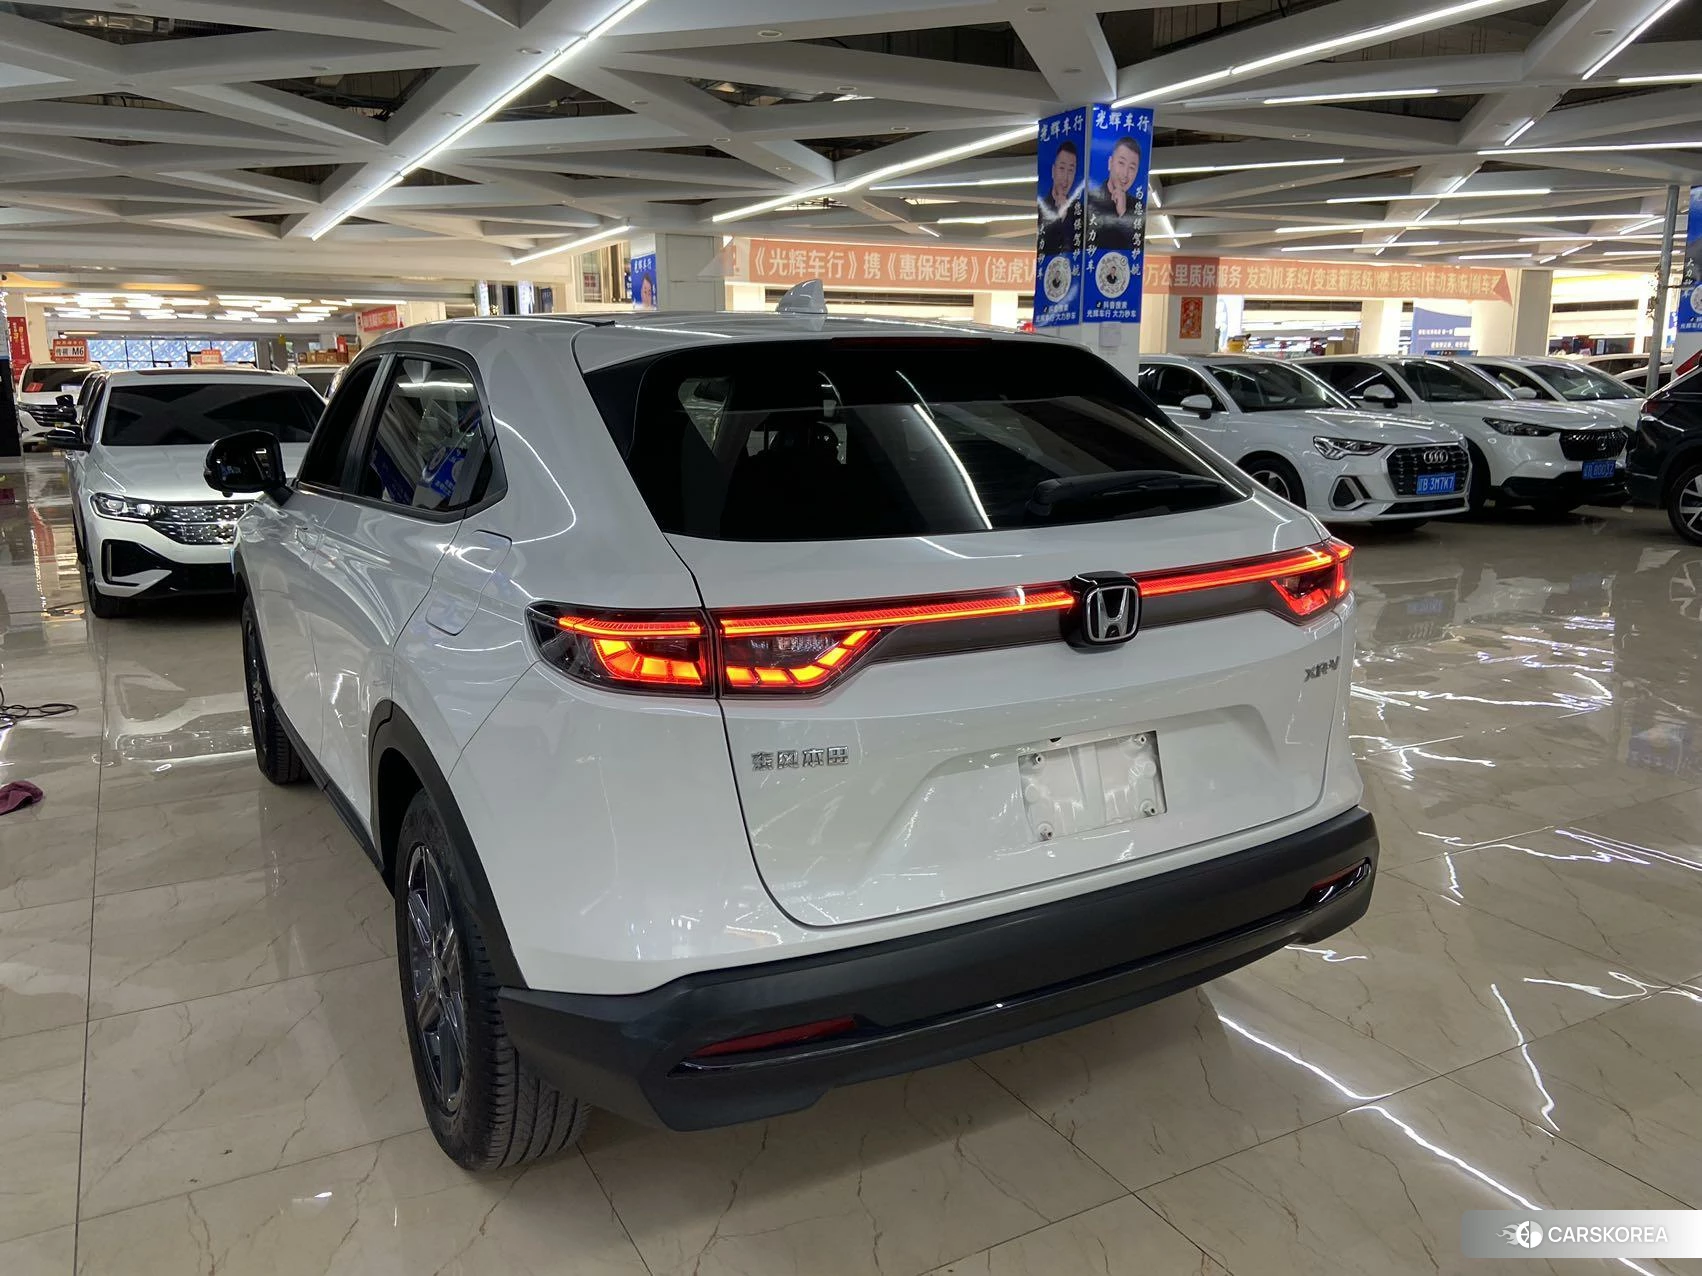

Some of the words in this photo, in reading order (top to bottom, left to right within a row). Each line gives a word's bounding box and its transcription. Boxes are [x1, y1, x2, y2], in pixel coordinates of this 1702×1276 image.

[1040, 114, 1083, 142] 光辉车行
[1095, 109, 1150, 133] 光辉车行
[1130, 185, 1144, 276] 为您保驾护航
[1145, 263, 1242, 289] 万公里质保服务
[751, 745, 849, 772] 东风本田
